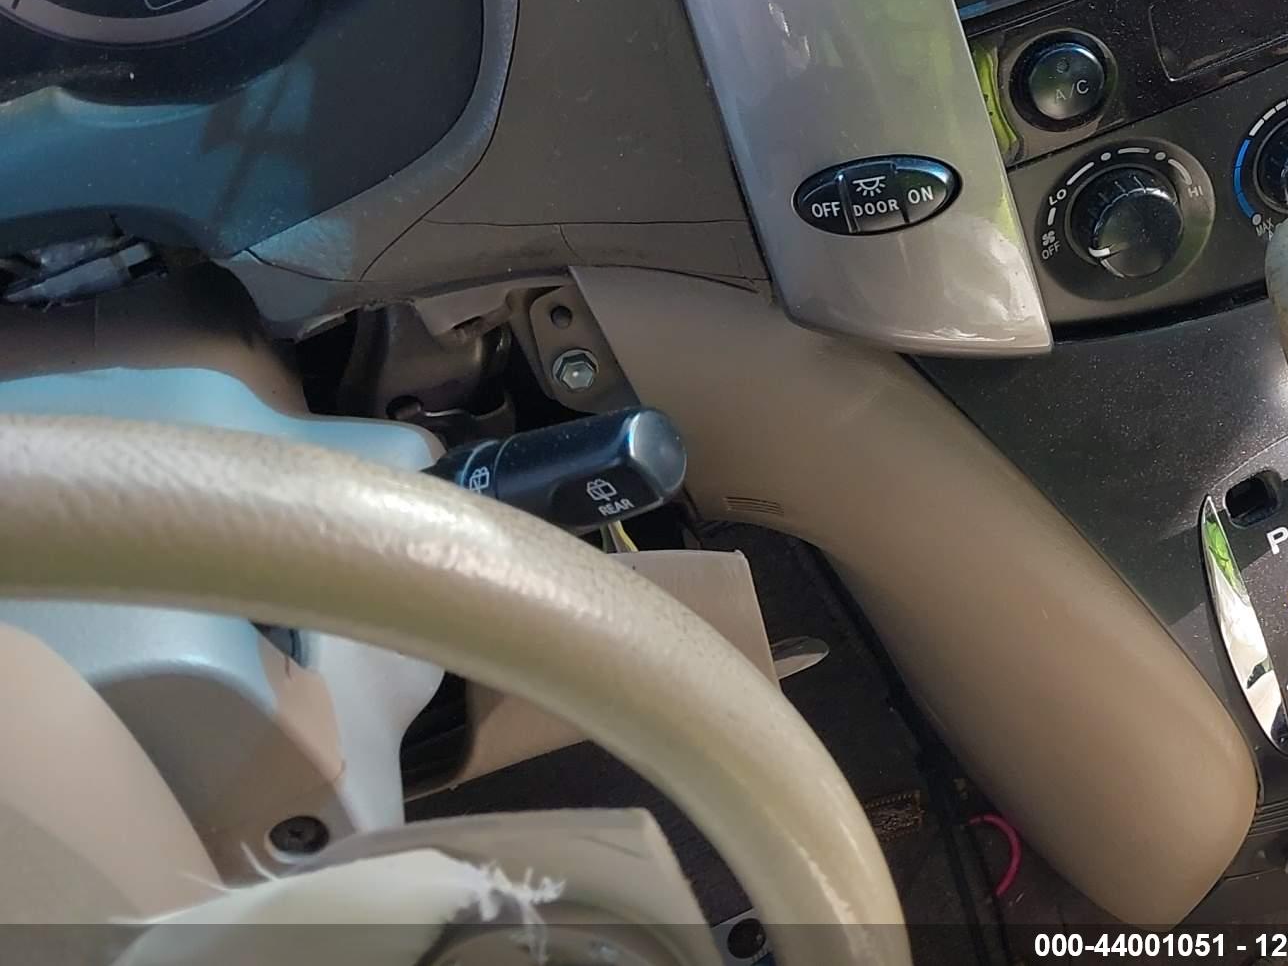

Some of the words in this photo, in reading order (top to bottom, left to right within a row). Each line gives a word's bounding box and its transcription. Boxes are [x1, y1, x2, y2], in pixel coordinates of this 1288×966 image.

[1055, 79, 1090, 101] A/C
[1049, 188, 1067, 206] LO
[1188, 185, 1205, 199] HI
[812, 201, 841, 218] OFF
[853, 199, 899, 217] DOOR
[908, 185, 933, 204] ON
[1041, 243, 1061, 261] OFF
[598, 498, 635, 516] REAR
[1266, 526, 1288, 555] P
